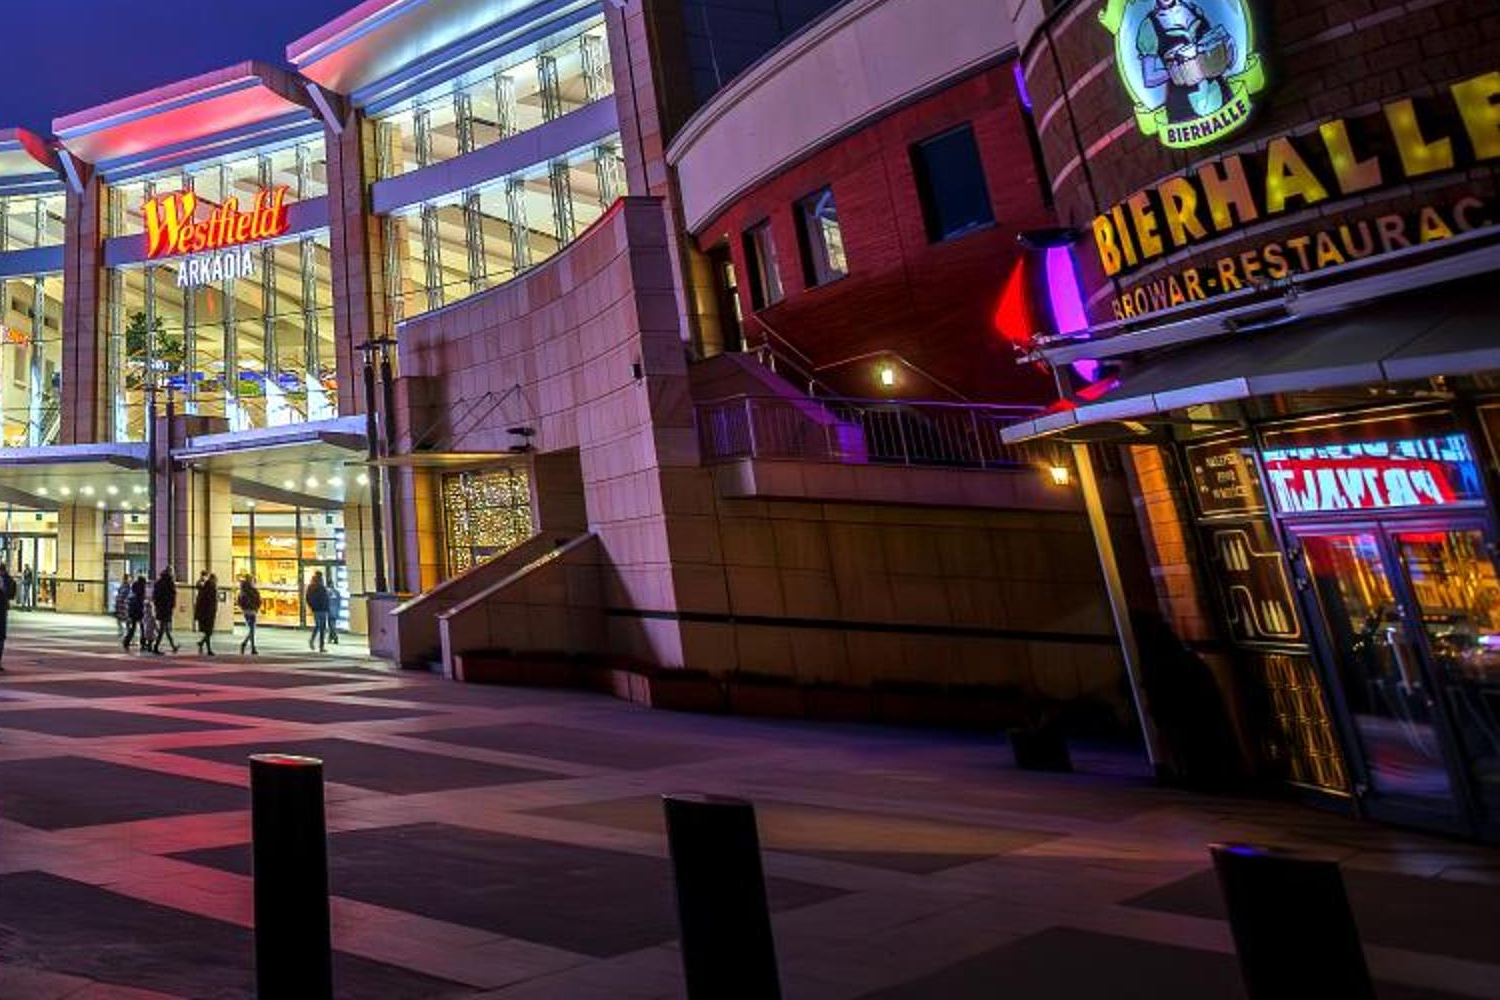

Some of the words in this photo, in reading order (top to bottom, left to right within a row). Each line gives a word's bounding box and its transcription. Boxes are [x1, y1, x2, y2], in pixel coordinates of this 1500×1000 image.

[1167, 100, 1247, 144] BIERHALLE
[1092, 71, 1500, 277] BIERHALLE
[143, 185, 287, 258] Westfield
[178, 251, 254, 287] ARKADIA
